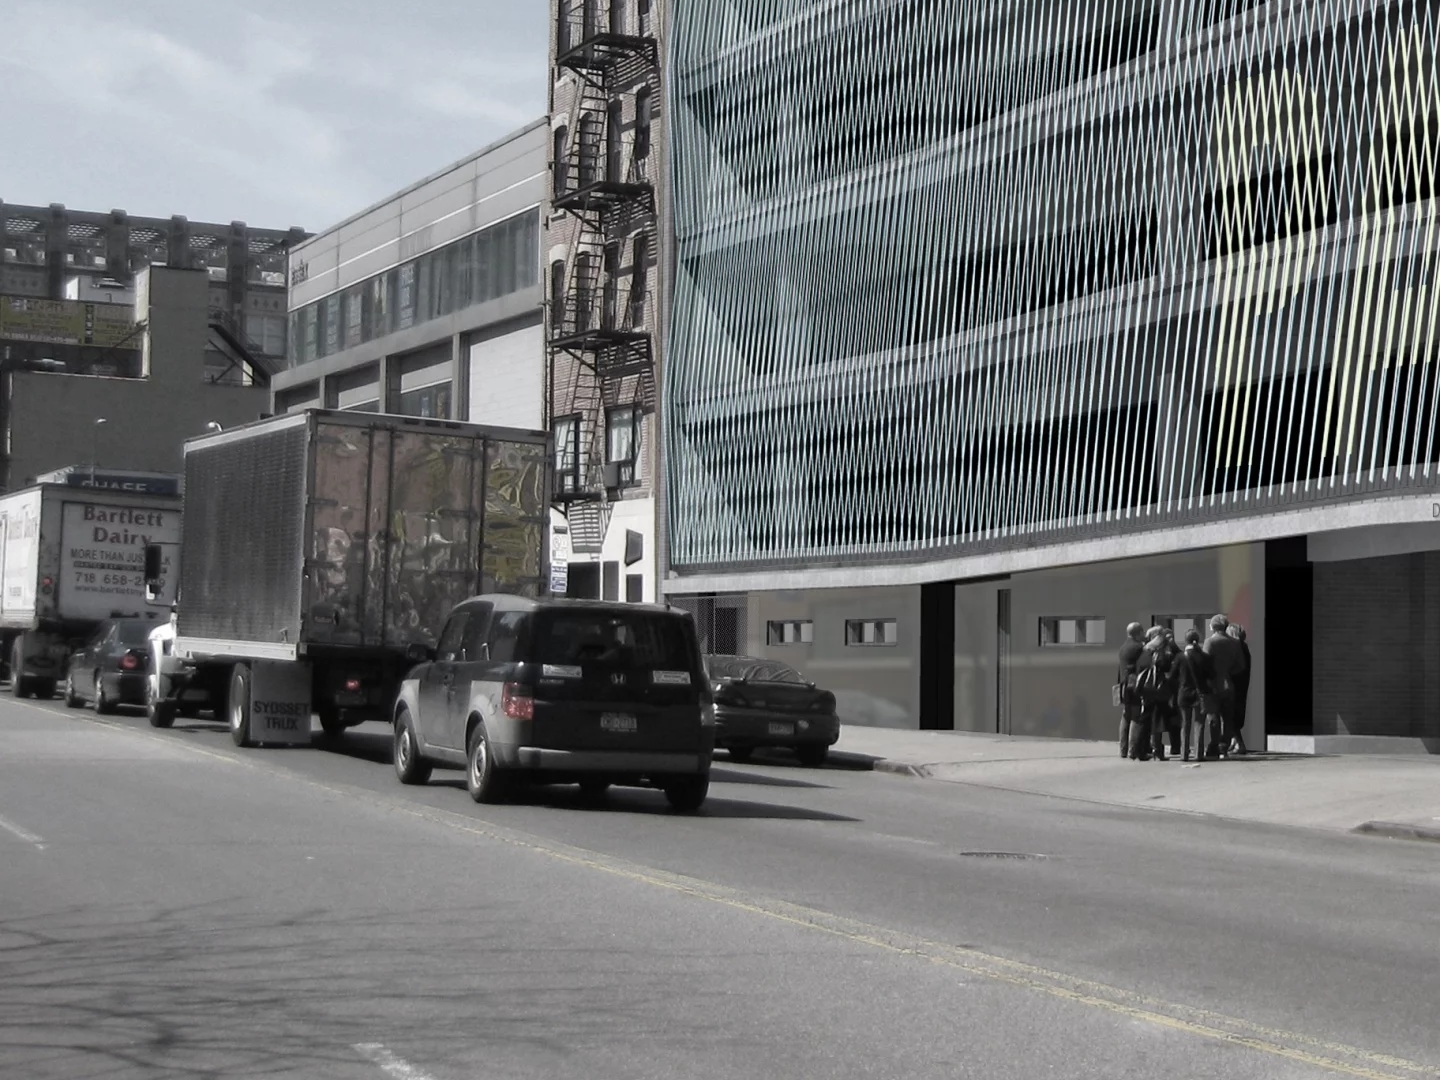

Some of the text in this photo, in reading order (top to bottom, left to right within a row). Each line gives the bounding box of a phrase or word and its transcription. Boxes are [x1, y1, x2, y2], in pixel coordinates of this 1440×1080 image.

[83, 504, 164, 527] Bartlett
[92, 526, 152, 550] Dairy
[70, 548, 97, 560] MORE
[100, 550, 125, 561] THAN
[75, 572, 96, 584] 718
[253, 700, 311, 715] SYOSSET
